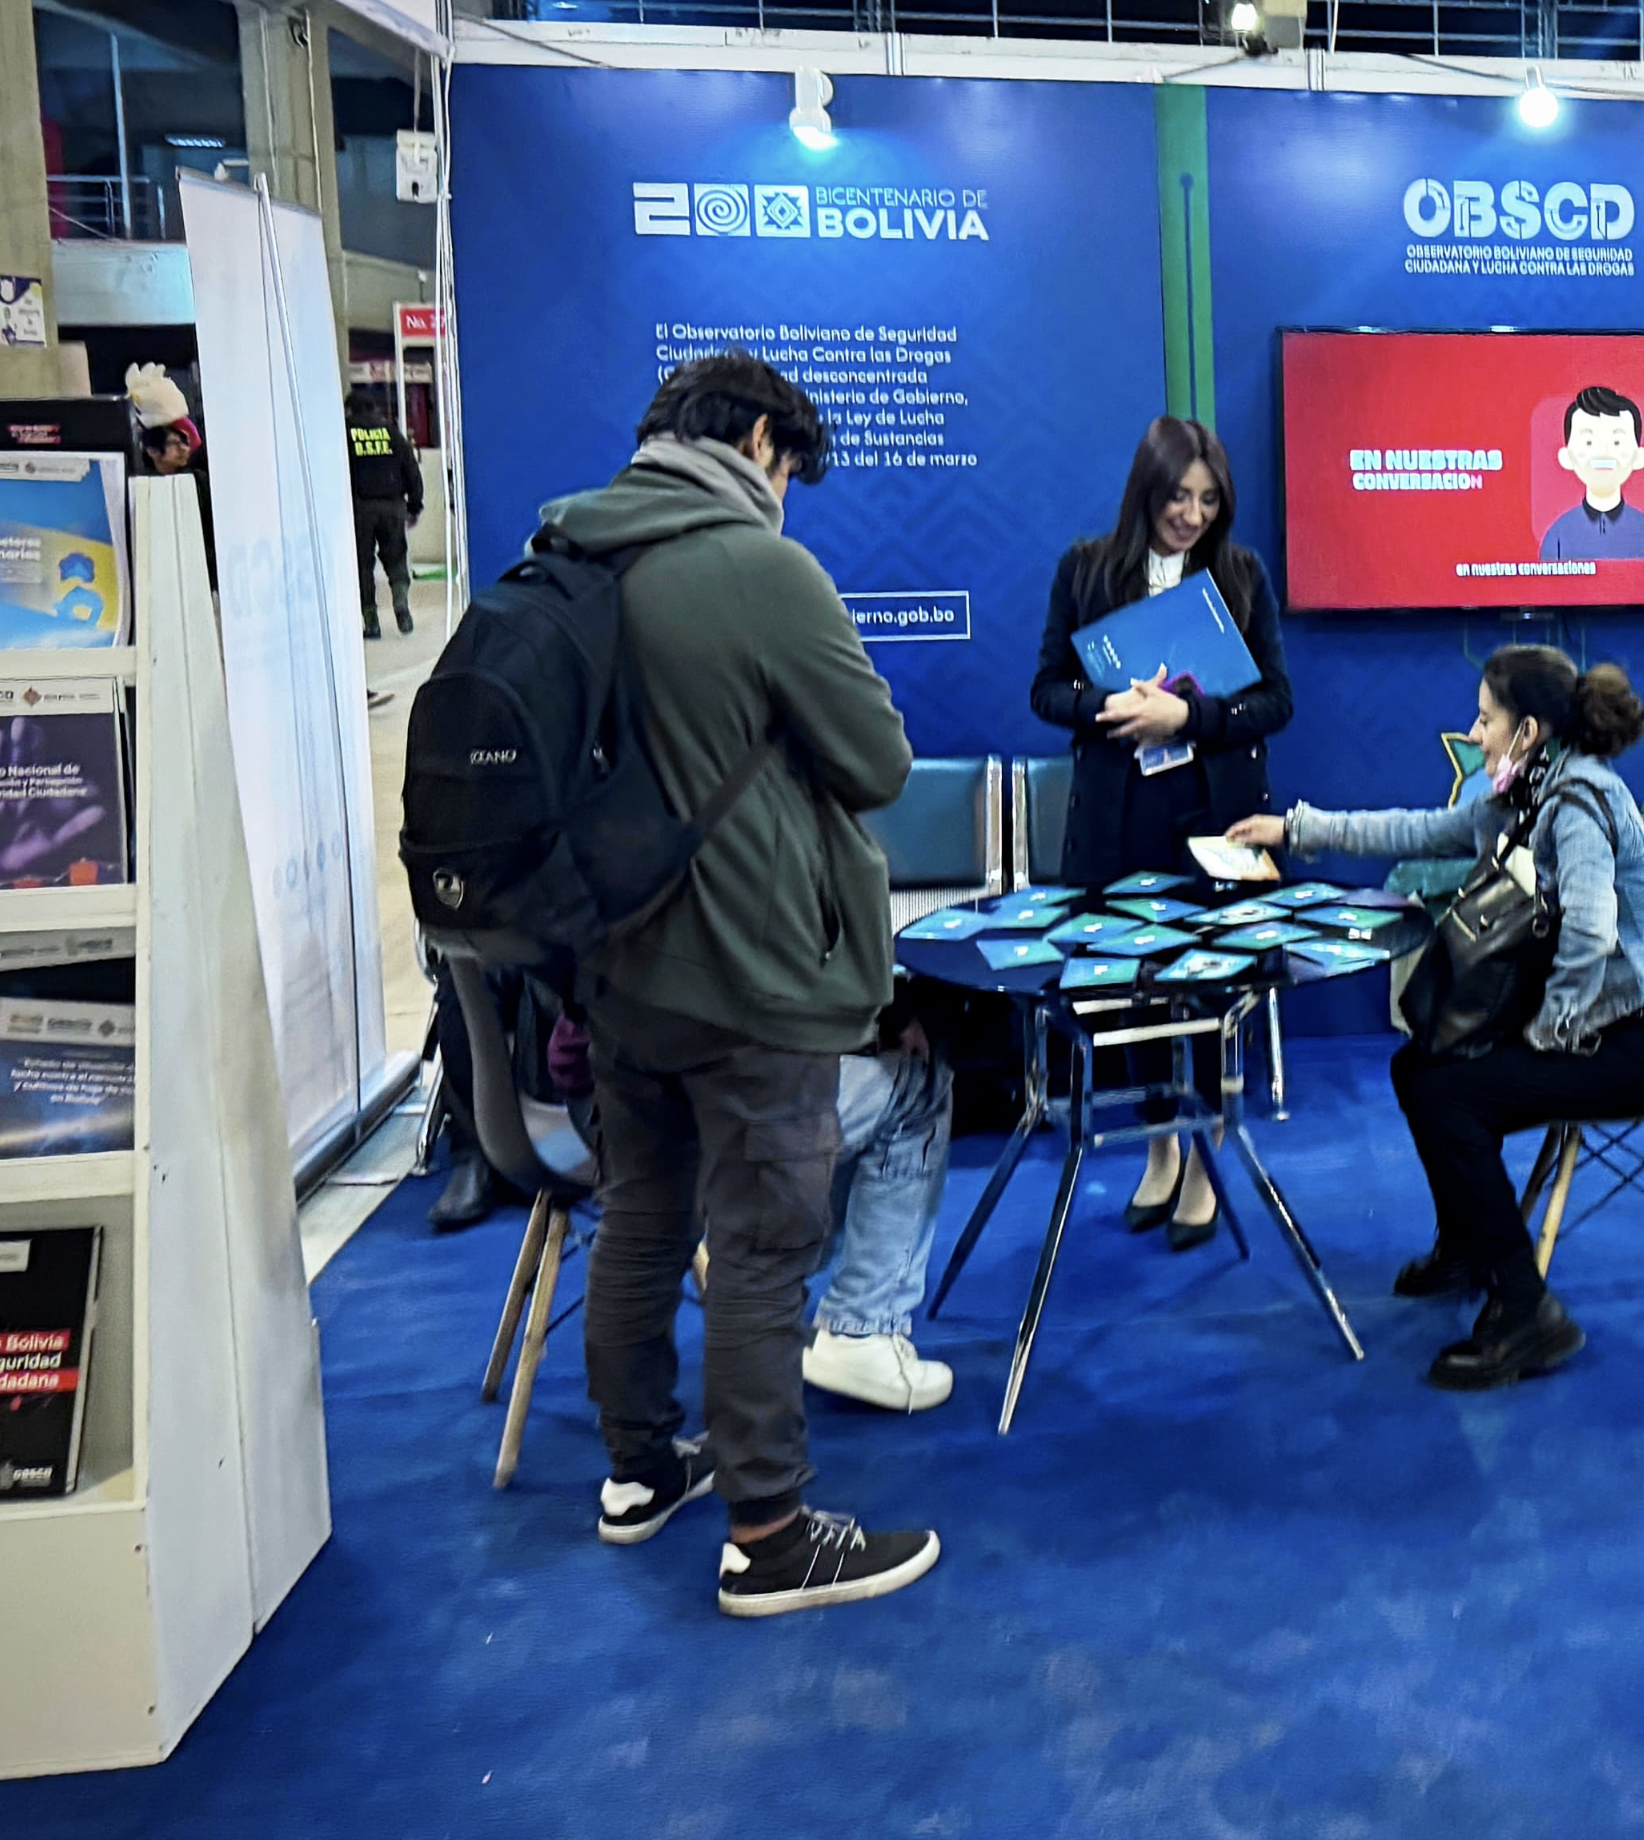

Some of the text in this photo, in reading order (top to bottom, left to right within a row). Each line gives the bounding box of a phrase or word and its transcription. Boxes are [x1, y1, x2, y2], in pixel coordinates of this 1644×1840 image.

[816, 186, 987, 209] BICENTENARIO DE
[1403, 178, 1635, 241] OBSCD
[817, 207, 990, 241] BOLIVIA
[1406, 244, 1633, 262] OBSERVATORIO BOLIVIANO DE SEGURIDAD
[1405, 259, 1635, 276] CIUDADANA Y LUCHA CONTRA LAS DROGAS
[656, 323, 958, 345] El Observatorio Boliviano de Seguridad
[762, 346, 808, 363] Lucha
[812, 346, 866, 363] Contra
[870, 346, 891, 363] las
[896, 347, 951, 366] Drogas
[802, 366, 927, 384] desconcentrada
[870, 388, 890, 405] de
[893, 389, 969, 407] Gobierno,
[846, 409, 872, 428] Ley
[875, 409, 896, 425] de
[900, 410, 945, 426] Lucha
[840, 429, 944, 447] de Sustancias
[854, 450, 878, 467] del
[884, 451, 903, 467] 16
[906, 451, 927, 467] de
[930, 454, 977, 467] marzo
[1350, 449, 1502, 471] EN NUESTRAS
[1456, 560, 1596, 577] en nuestras conversaciones
[63, 762, 80, 775] de
[7, 1334, 64, 1350] Bolivia
